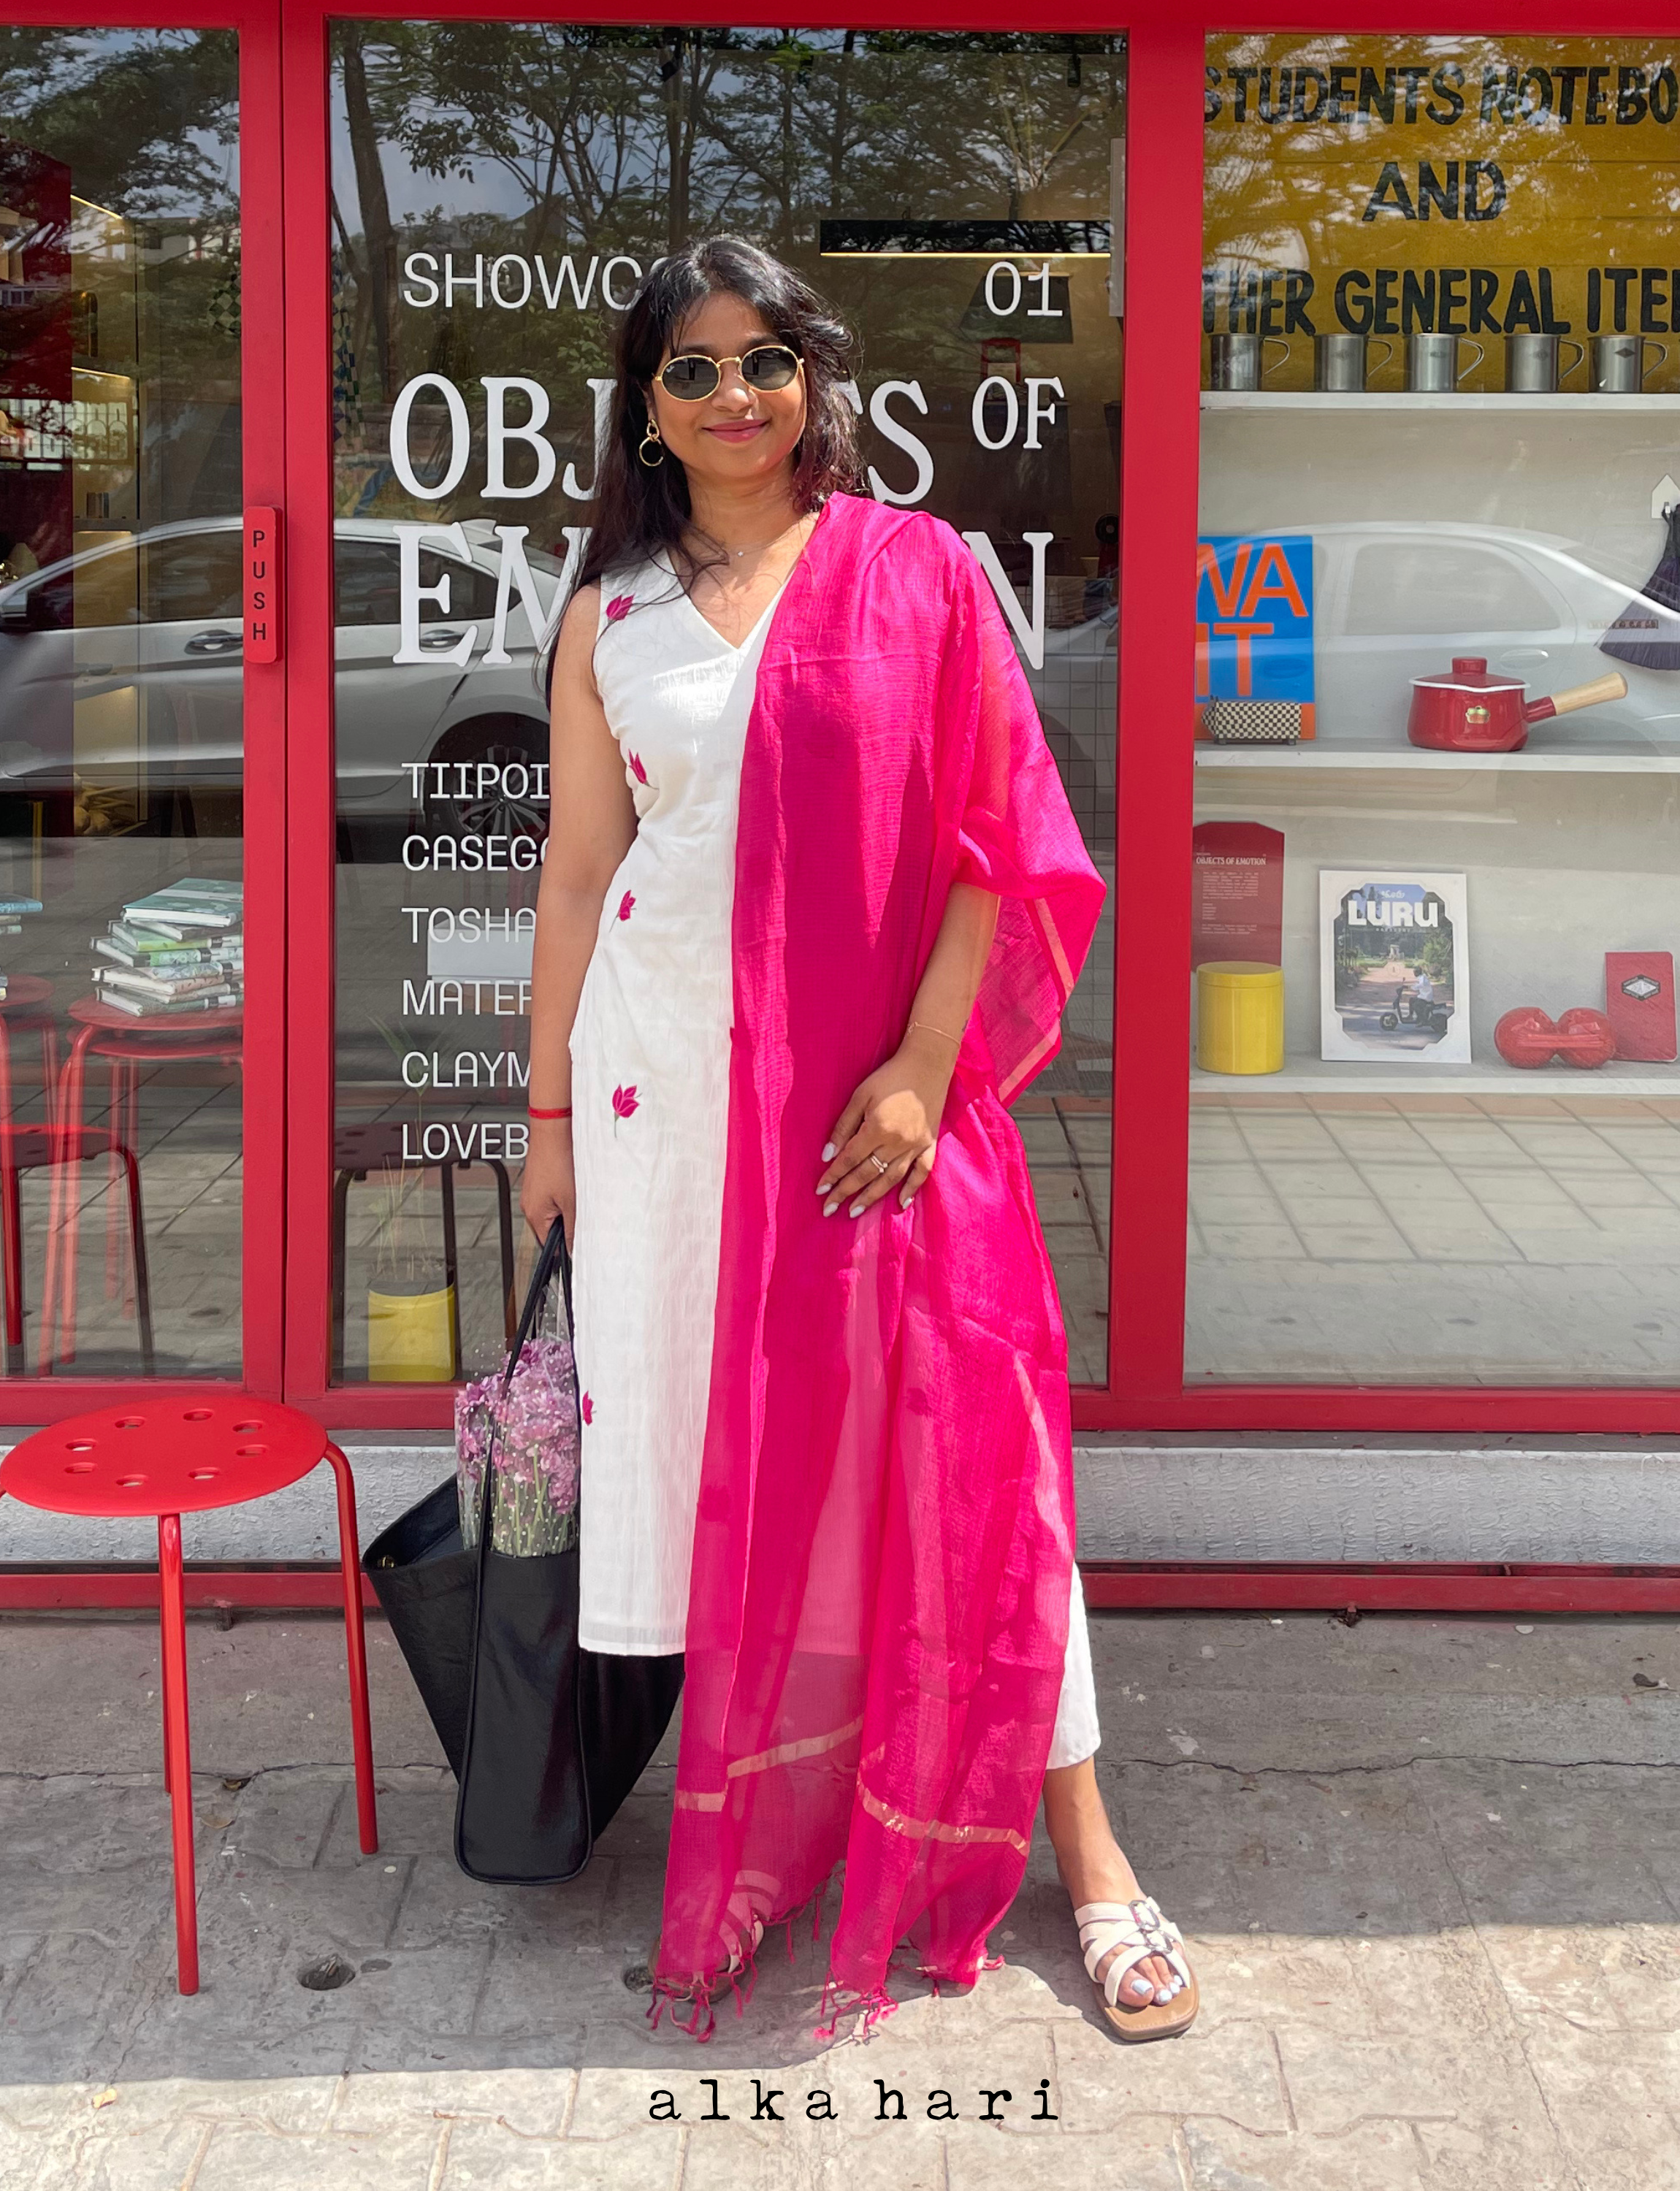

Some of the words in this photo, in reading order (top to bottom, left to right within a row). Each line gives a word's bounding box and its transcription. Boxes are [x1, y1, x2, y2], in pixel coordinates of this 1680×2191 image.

[1362, 161, 1506, 221] AND
[403, 252, 671, 310] SHOWC
[985, 261, 1064, 316] 01
[1335, 268, 1570, 334] GENERAL
[971, 375, 1064, 450] OF
[253, 530, 267, 641] PUSH
[1348, 900, 1438, 928] LURU
[402, 1123, 529, 1160] LOVEB
